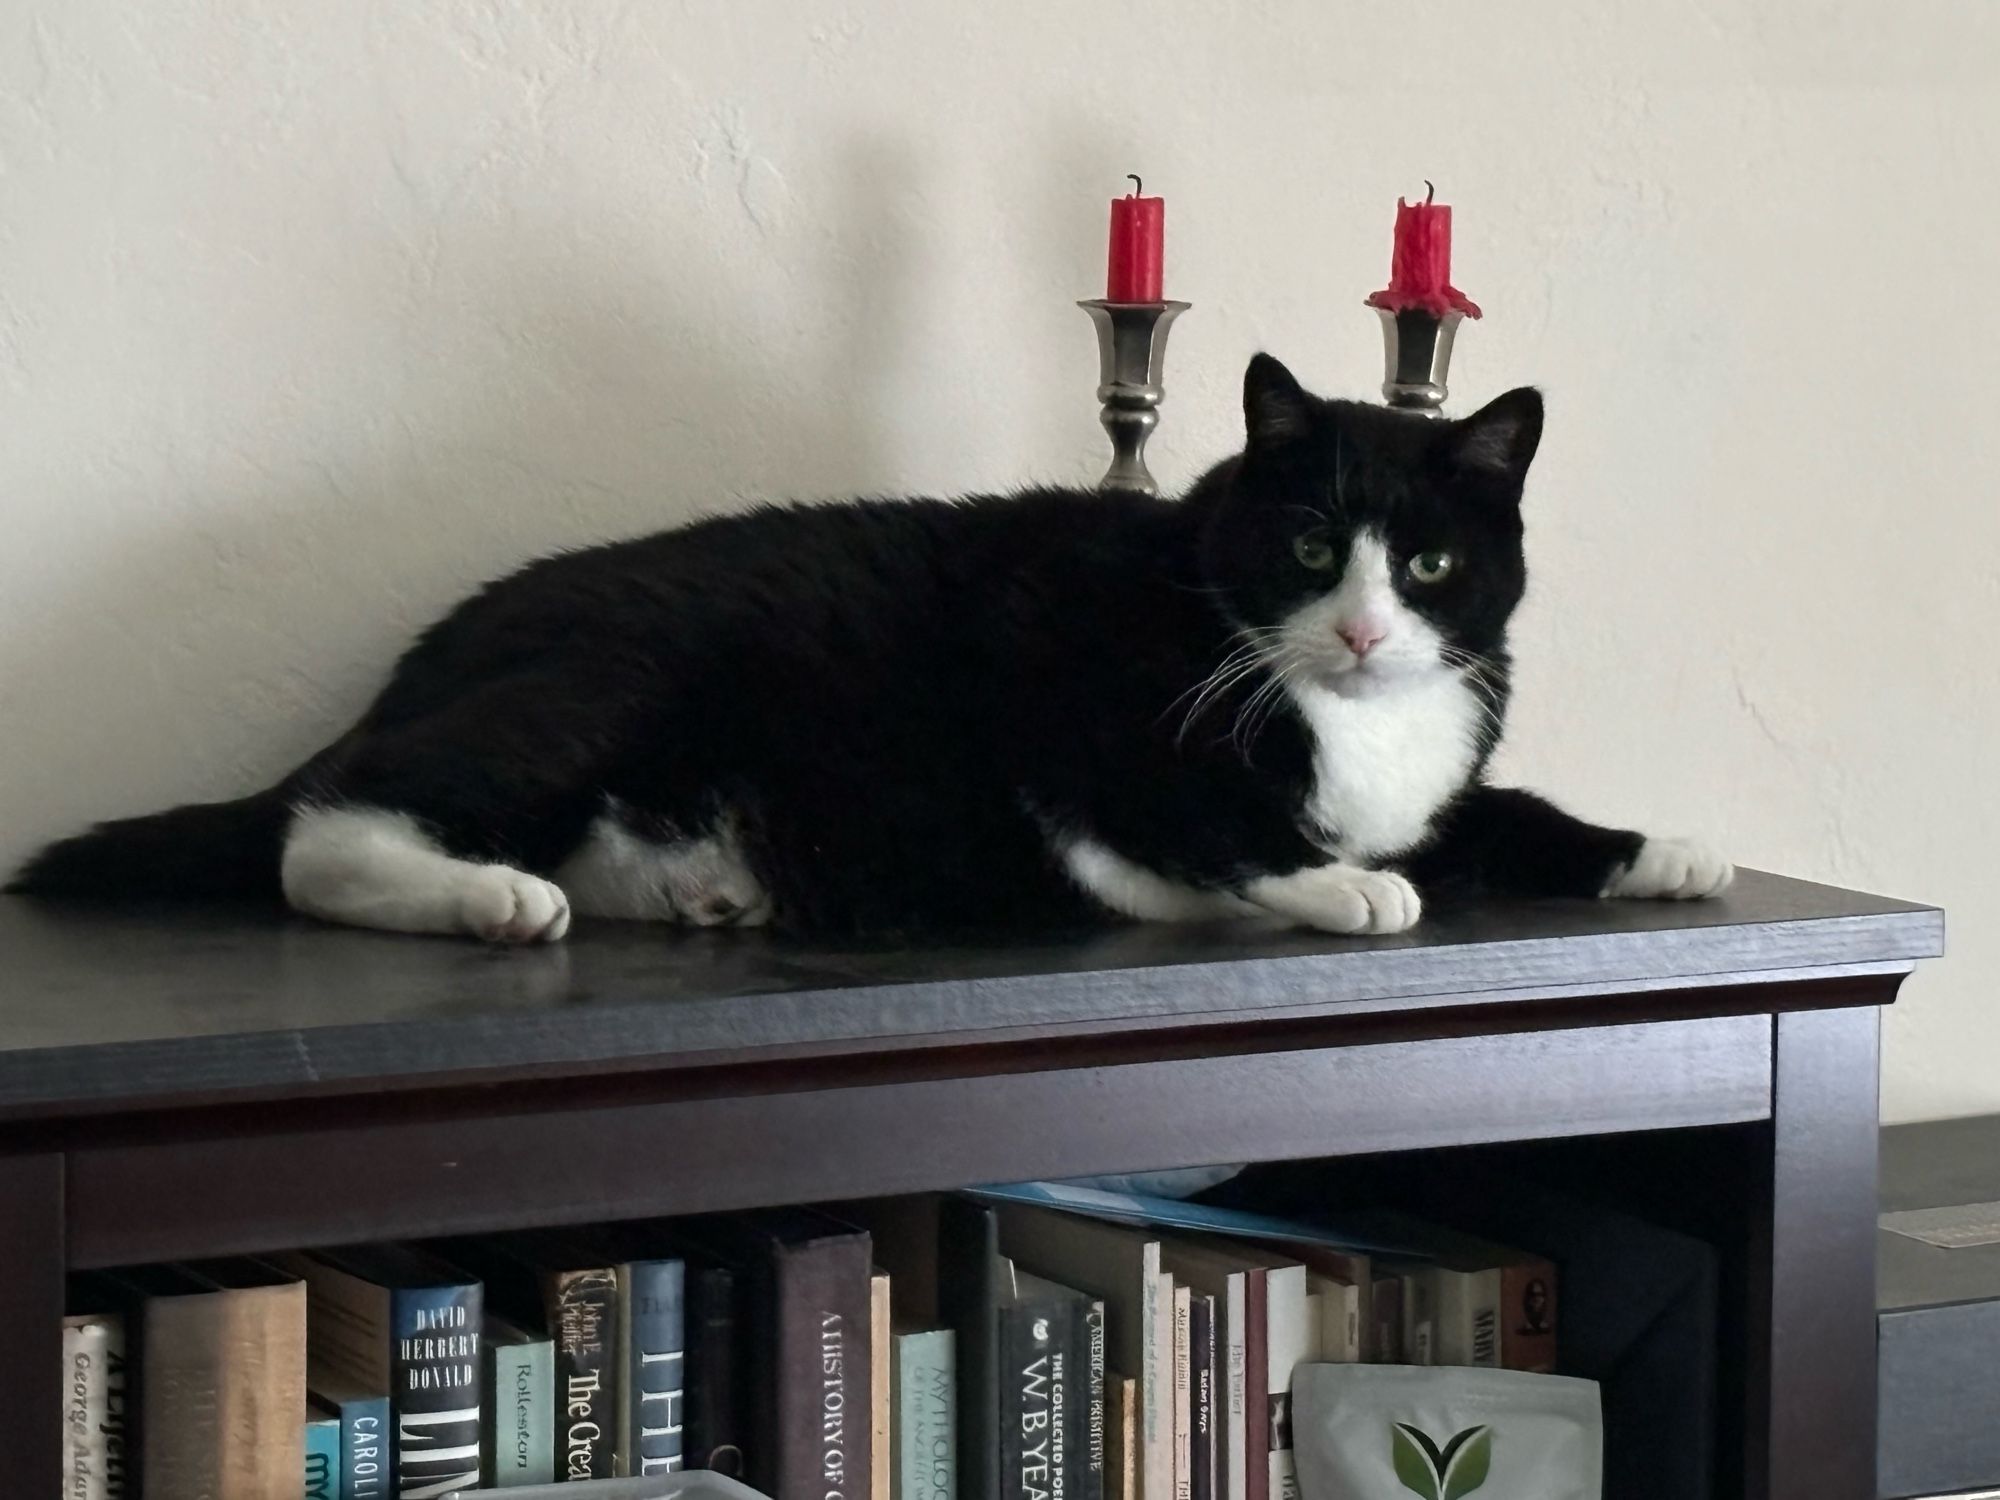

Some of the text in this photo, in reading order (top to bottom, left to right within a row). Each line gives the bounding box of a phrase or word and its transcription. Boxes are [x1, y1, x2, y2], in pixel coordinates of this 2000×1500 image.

[416, 1305, 466, 1331] DAVID
[400, 1333, 479, 1361] HERBERT
[1052, 1352, 1063, 1381] THE
[69, 1352, 92, 1435] George
[409, 1364, 473, 1390] DONALD
[567, 1368, 600, 1417] The
[821, 1330, 845, 1446] HISTORY
[516, 1363, 532, 1469] Rolleston
[1052, 1383, 1063, 1464] COLLECTED
[823, 1448, 845, 1486] OF
